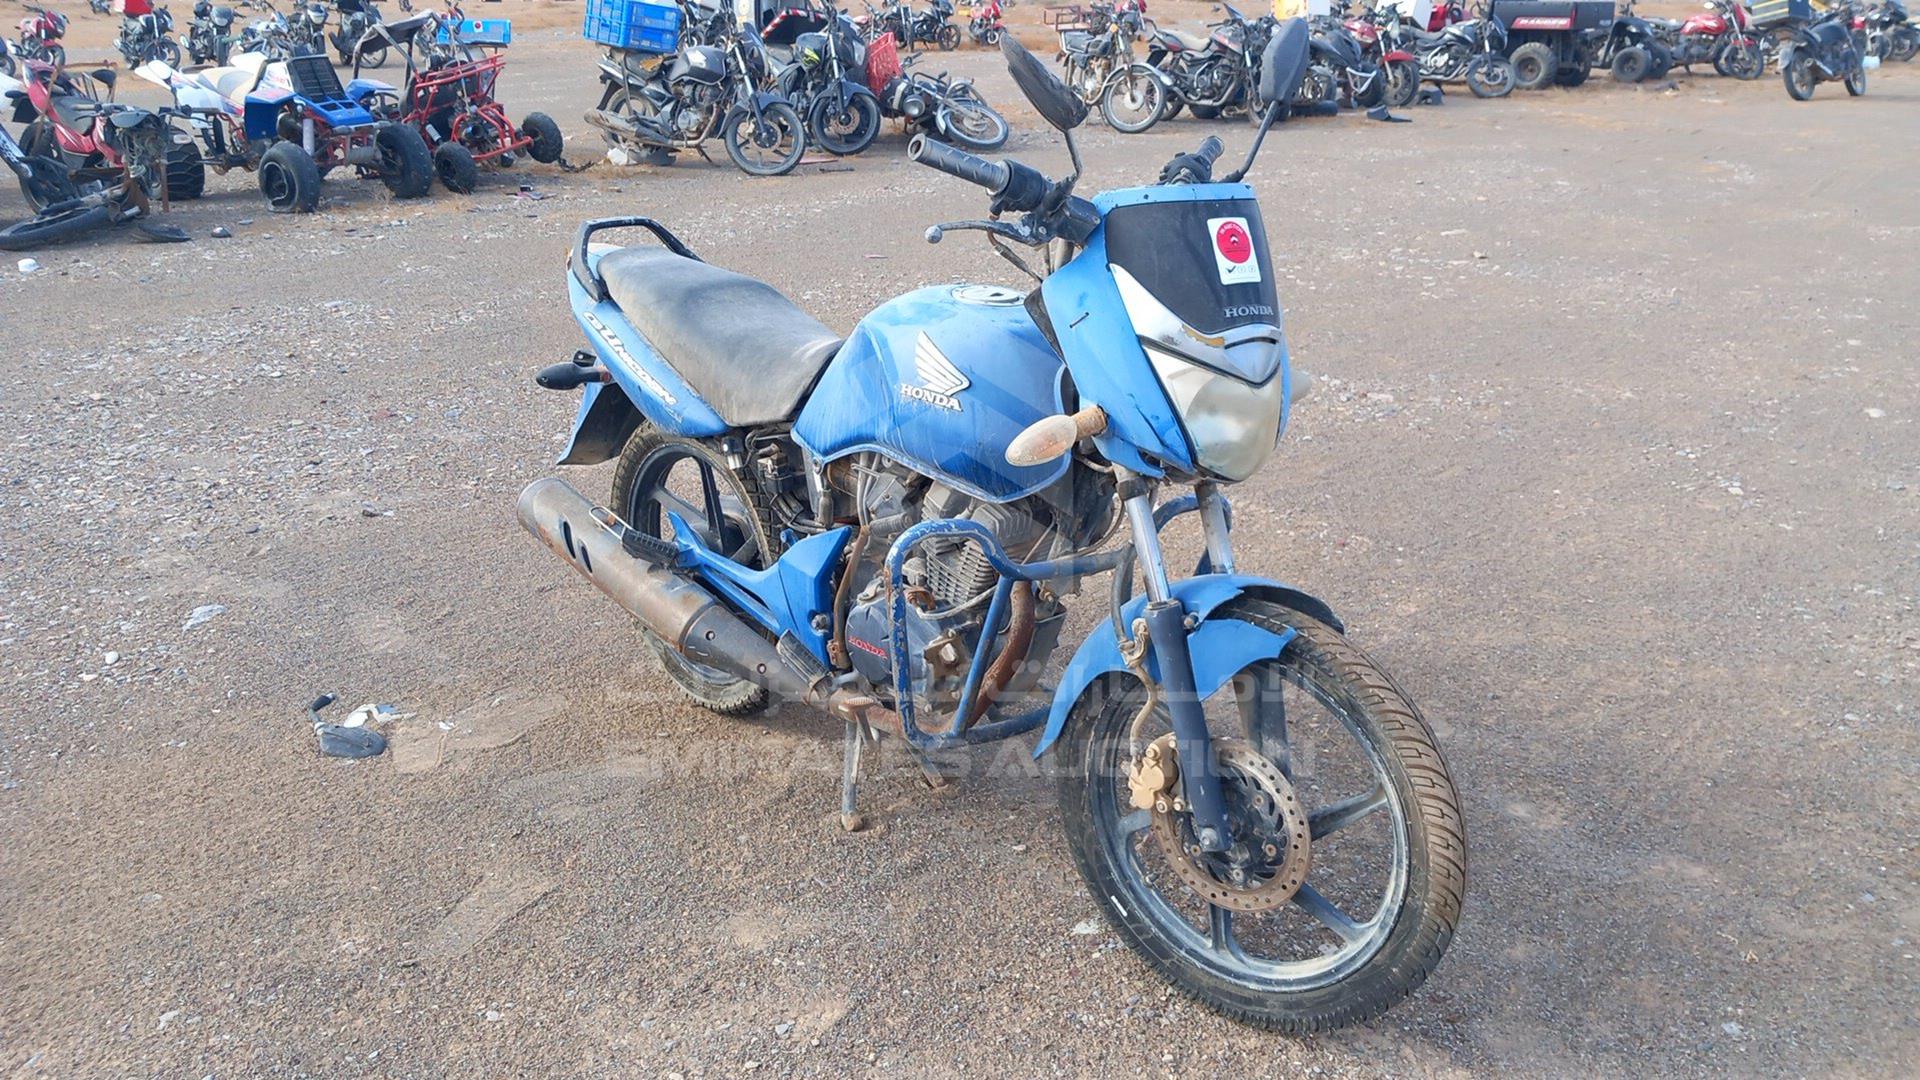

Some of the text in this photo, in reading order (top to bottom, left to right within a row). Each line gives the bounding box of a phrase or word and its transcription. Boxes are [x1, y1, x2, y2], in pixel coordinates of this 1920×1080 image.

[1224, 306, 1274, 318] HONDA
[900, 383, 963, 412] HONDA
[848, 635, 888, 660] HONDA
